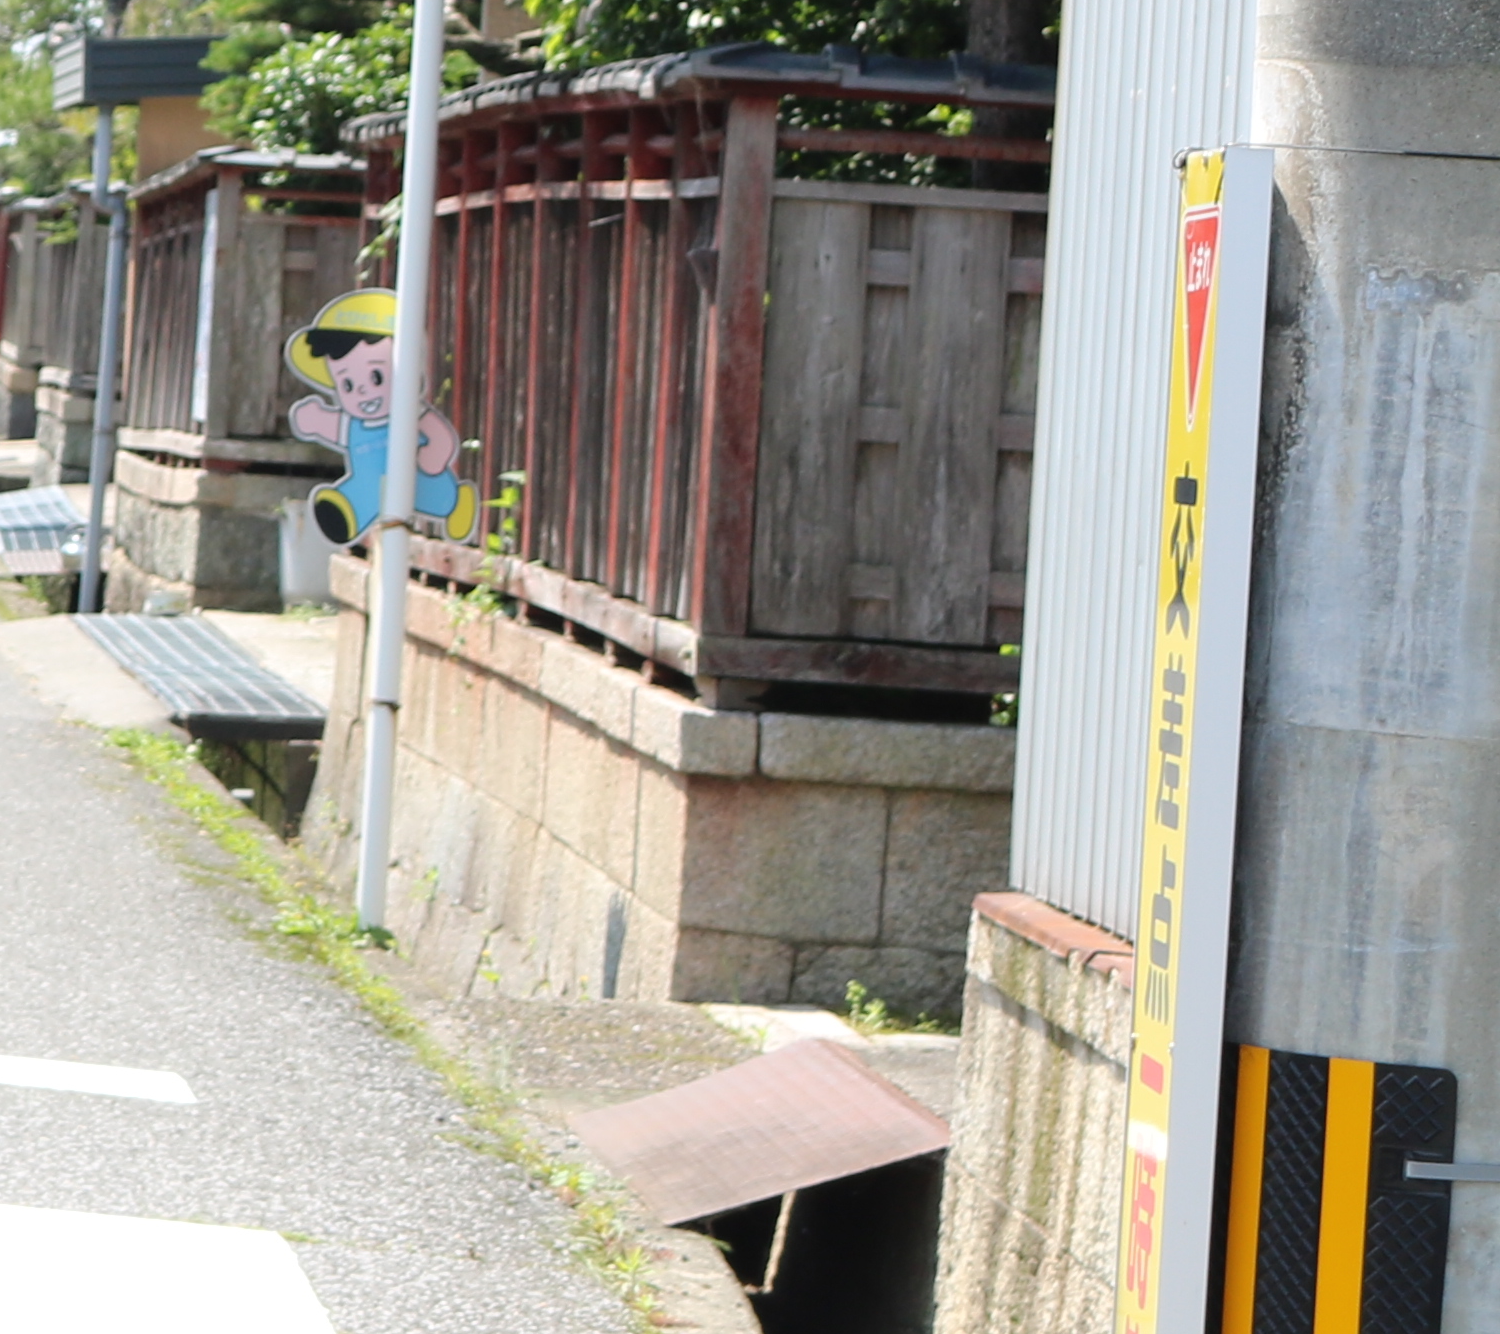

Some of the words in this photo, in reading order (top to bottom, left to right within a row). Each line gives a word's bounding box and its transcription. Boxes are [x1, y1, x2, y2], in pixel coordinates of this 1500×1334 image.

[1187, 240, 1212, 293] 止まれ
[1145, 462, 1199, 1026] 交差点
